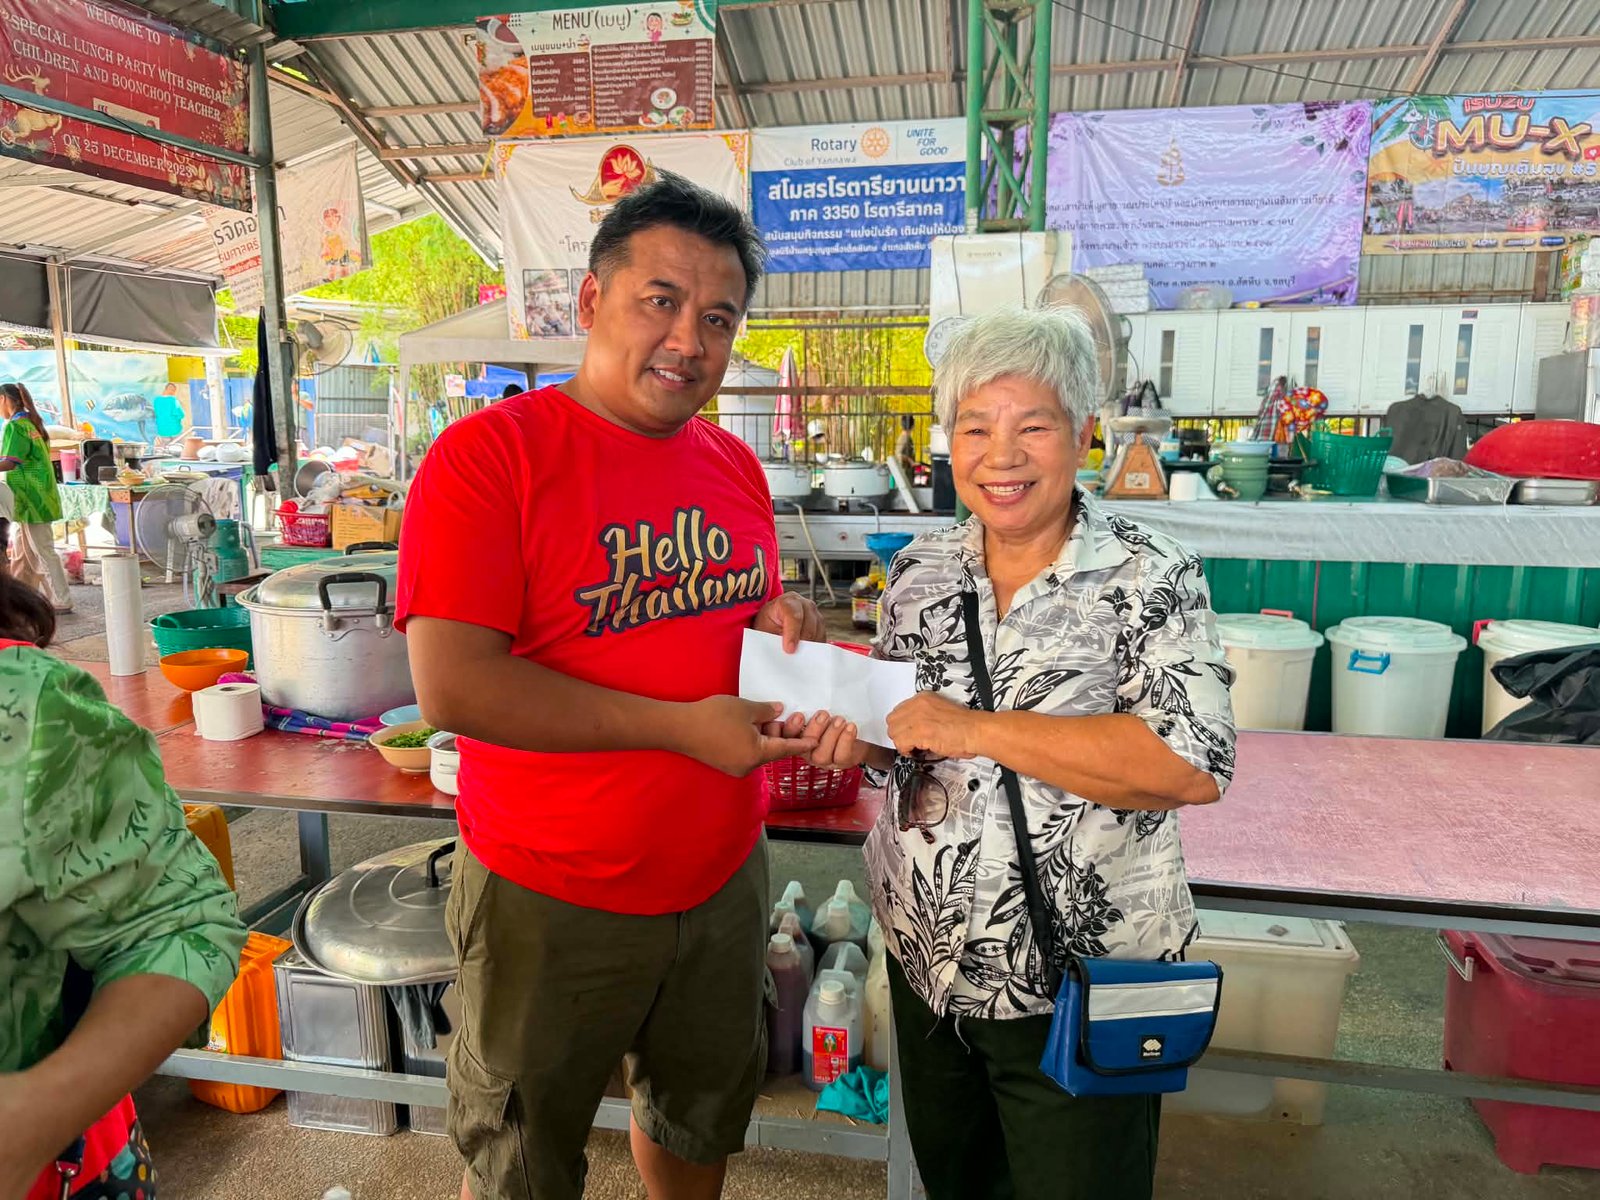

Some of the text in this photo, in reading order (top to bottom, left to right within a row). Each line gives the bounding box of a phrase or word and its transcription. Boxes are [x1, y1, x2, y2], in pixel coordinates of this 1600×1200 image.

[84, 3, 161, 45] WELCOME TO
[552, 8, 632, 31] MENU (เมนู)
[11, 15, 230, 106] SPECIAL LUNCH PARTY WITH SPECIAL
[13, 39, 220, 121] CHILDREN AND BOONCHOO TEACHER
[1464, 94, 1535, 113] ISUZU
[907, 128, 935, 138] UNITE
[917, 138, 936, 146] FOR
[1434, 113, 1592, 158] MU-X
[62, 133, 193, 178] ON 25 DECEMBER 2023
[811, 138, 857, 152] Rotary
[920, 147, 948, 156] GOOD
[784, 156, 857, 167] Club of Yannawa
[768, 174, 966, 200] สโมสรโรตารียานนาวา
[789, 201, 944, 221] ภาค 3350 โรตารีสากล
[559, 235, 588, 253] "โคร
[601, 507, 731, 584] Hello
[577, 546, 767, 634] Thailand
